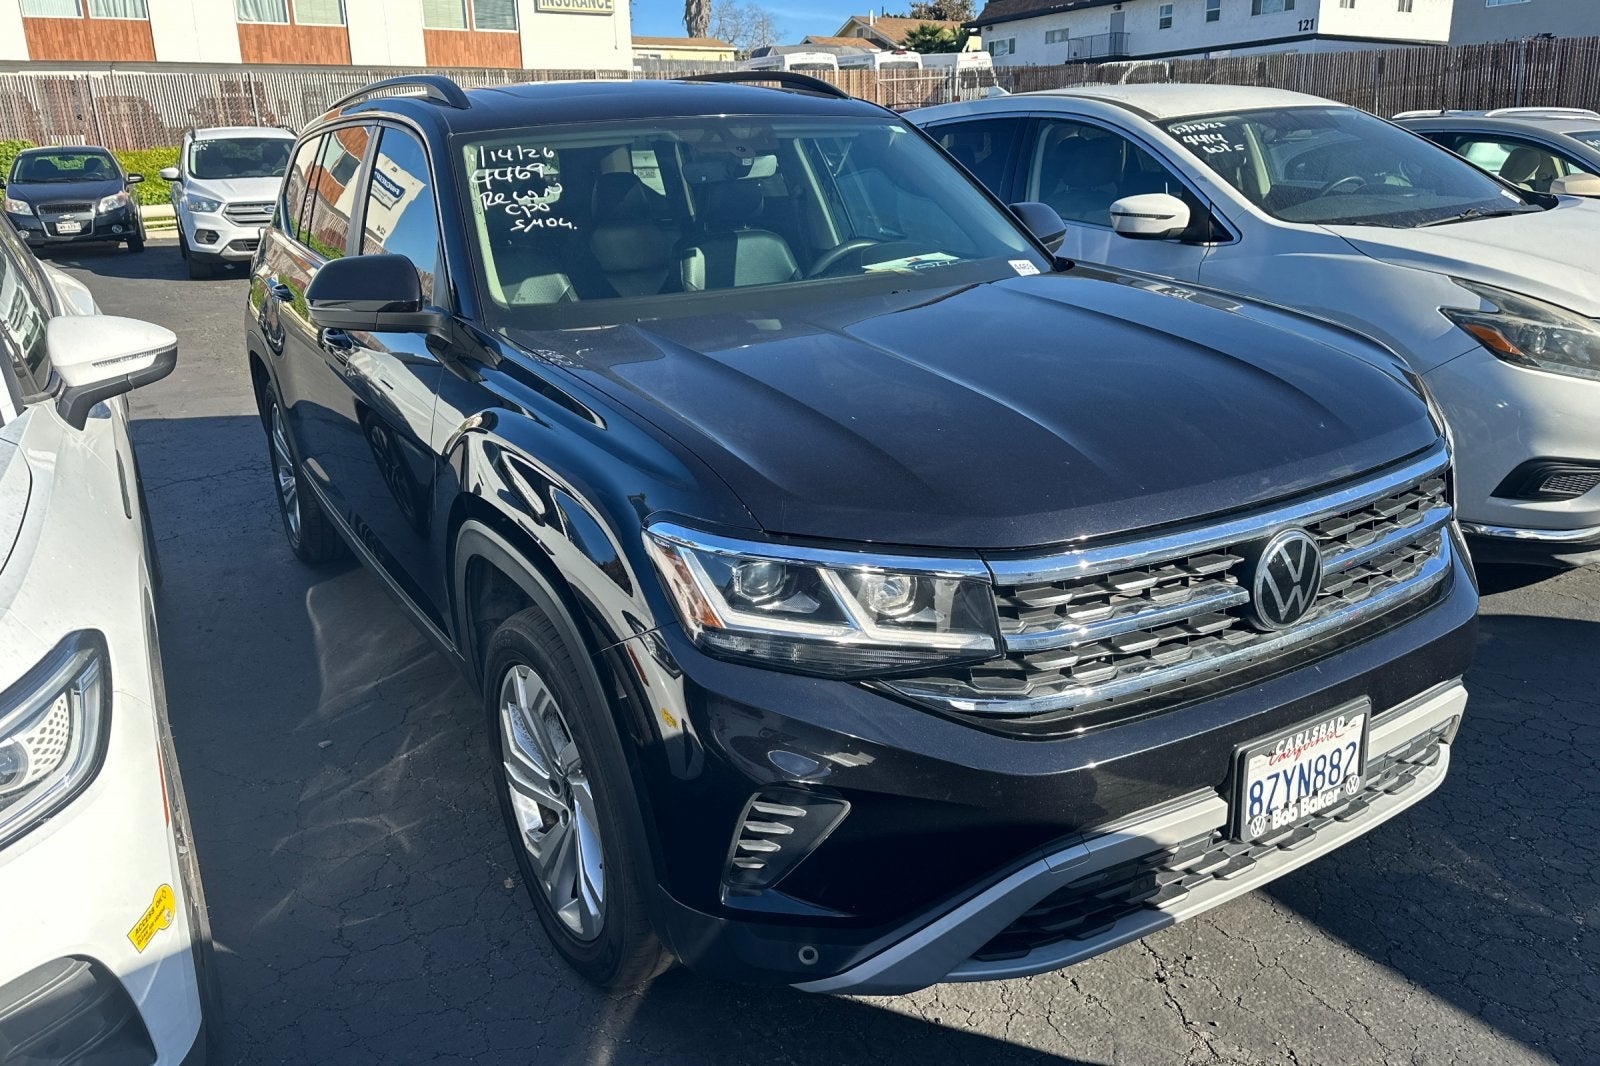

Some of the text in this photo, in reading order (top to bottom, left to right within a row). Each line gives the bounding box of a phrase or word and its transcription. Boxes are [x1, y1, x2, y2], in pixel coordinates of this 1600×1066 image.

[1298, 18, 1314, 31] 121
[471, 163, 546, 189] 4469
[1275, 716, 1345, 753] CARLSBAD
[1249, 741, 1357, 817] 8ZYN882
[1271, 805, 1299, 830] Bob
[1300, 786, 1341, 815] Baker
